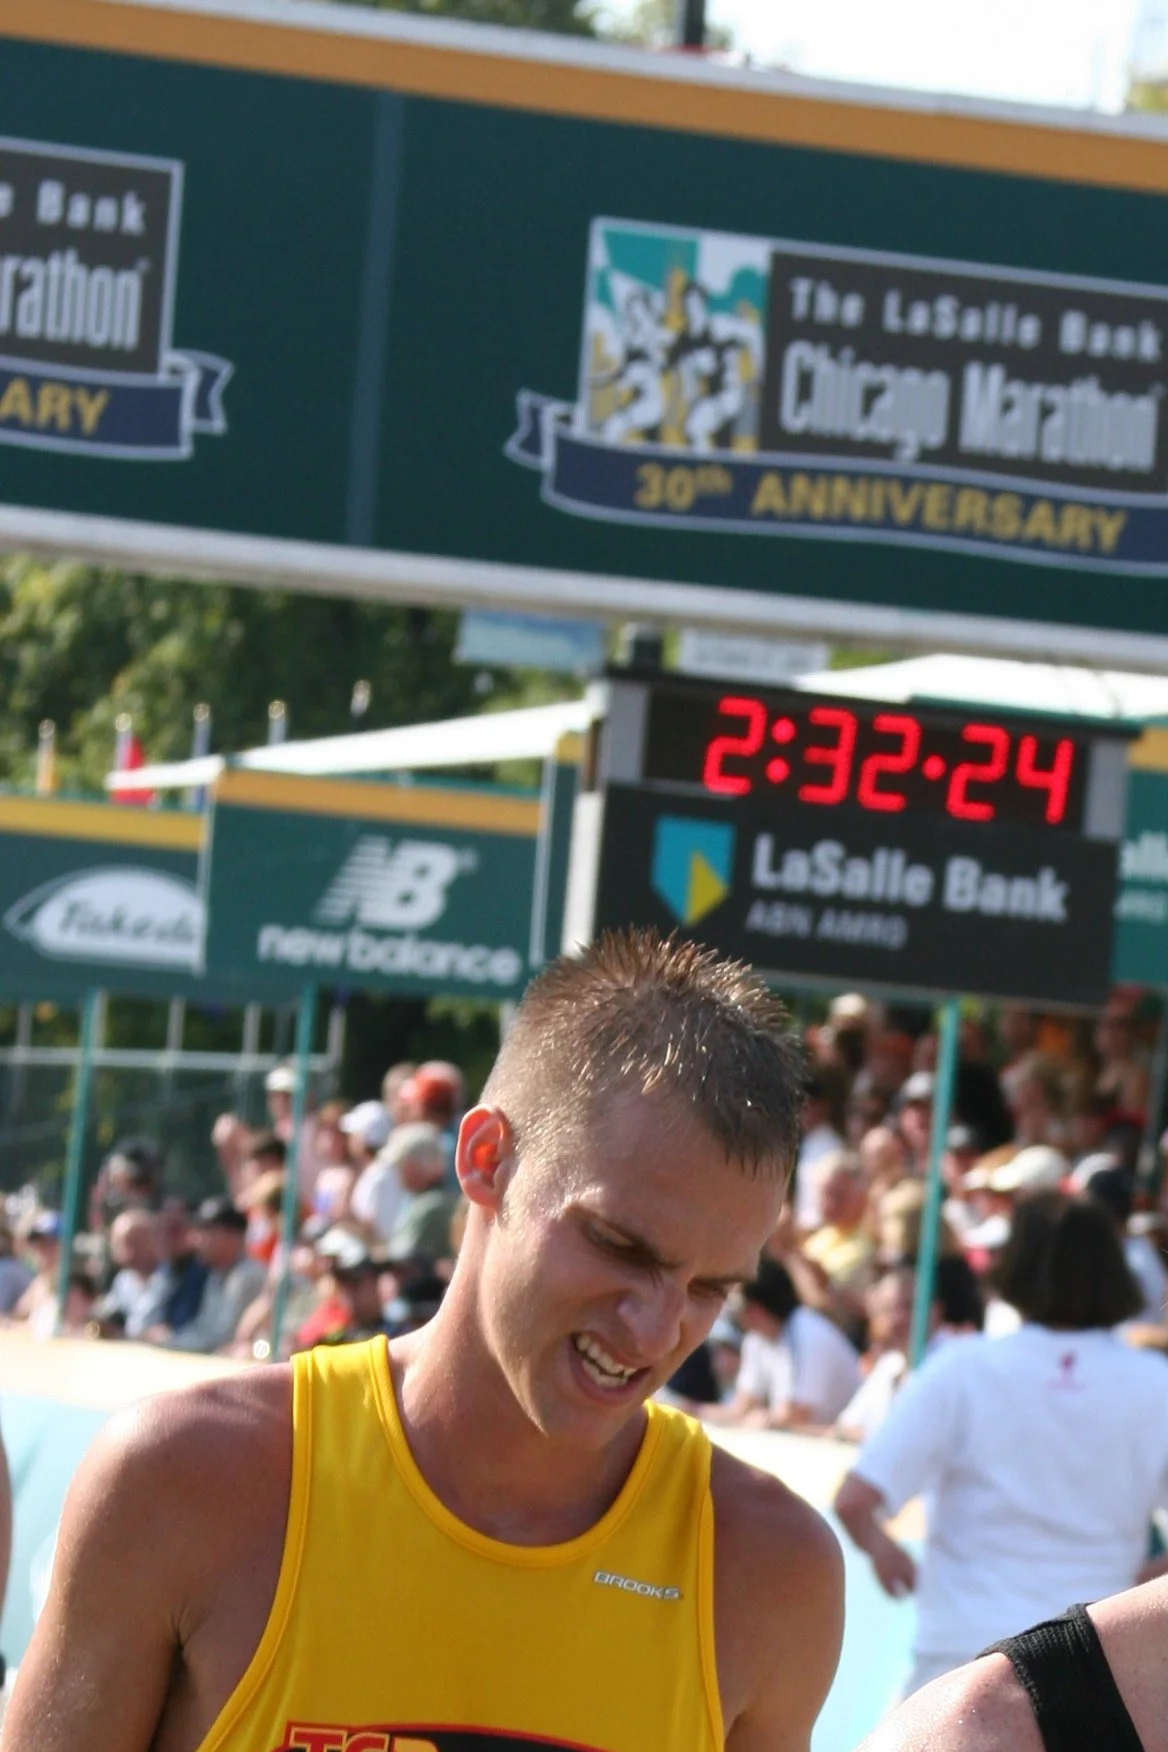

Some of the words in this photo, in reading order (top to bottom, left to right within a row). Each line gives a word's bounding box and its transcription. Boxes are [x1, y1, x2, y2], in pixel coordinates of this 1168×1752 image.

[36, 179, 145, 235] Bank
[789, 277, 863, 326] The
[884, 288, 1041, 351] LaSalle
[1058, 307, 1163, 364] Bank
[0, 376, 110, 437] ARY
[779, 339, 951, 466] Chicago
[959, 359, 1158, 474] Marathon
[634, 462, 733, 513] 30th
[750, 468, 1127, 555] ANNIVERSARY
[752, 832, 935, 907] LaSalle
[942, 855, 1070, 922] Bank
[745, 900, 811, 939] ABN
[815, 907, 909, 950] AMRO
[594, 1571, 680, 1599] BROOKS
